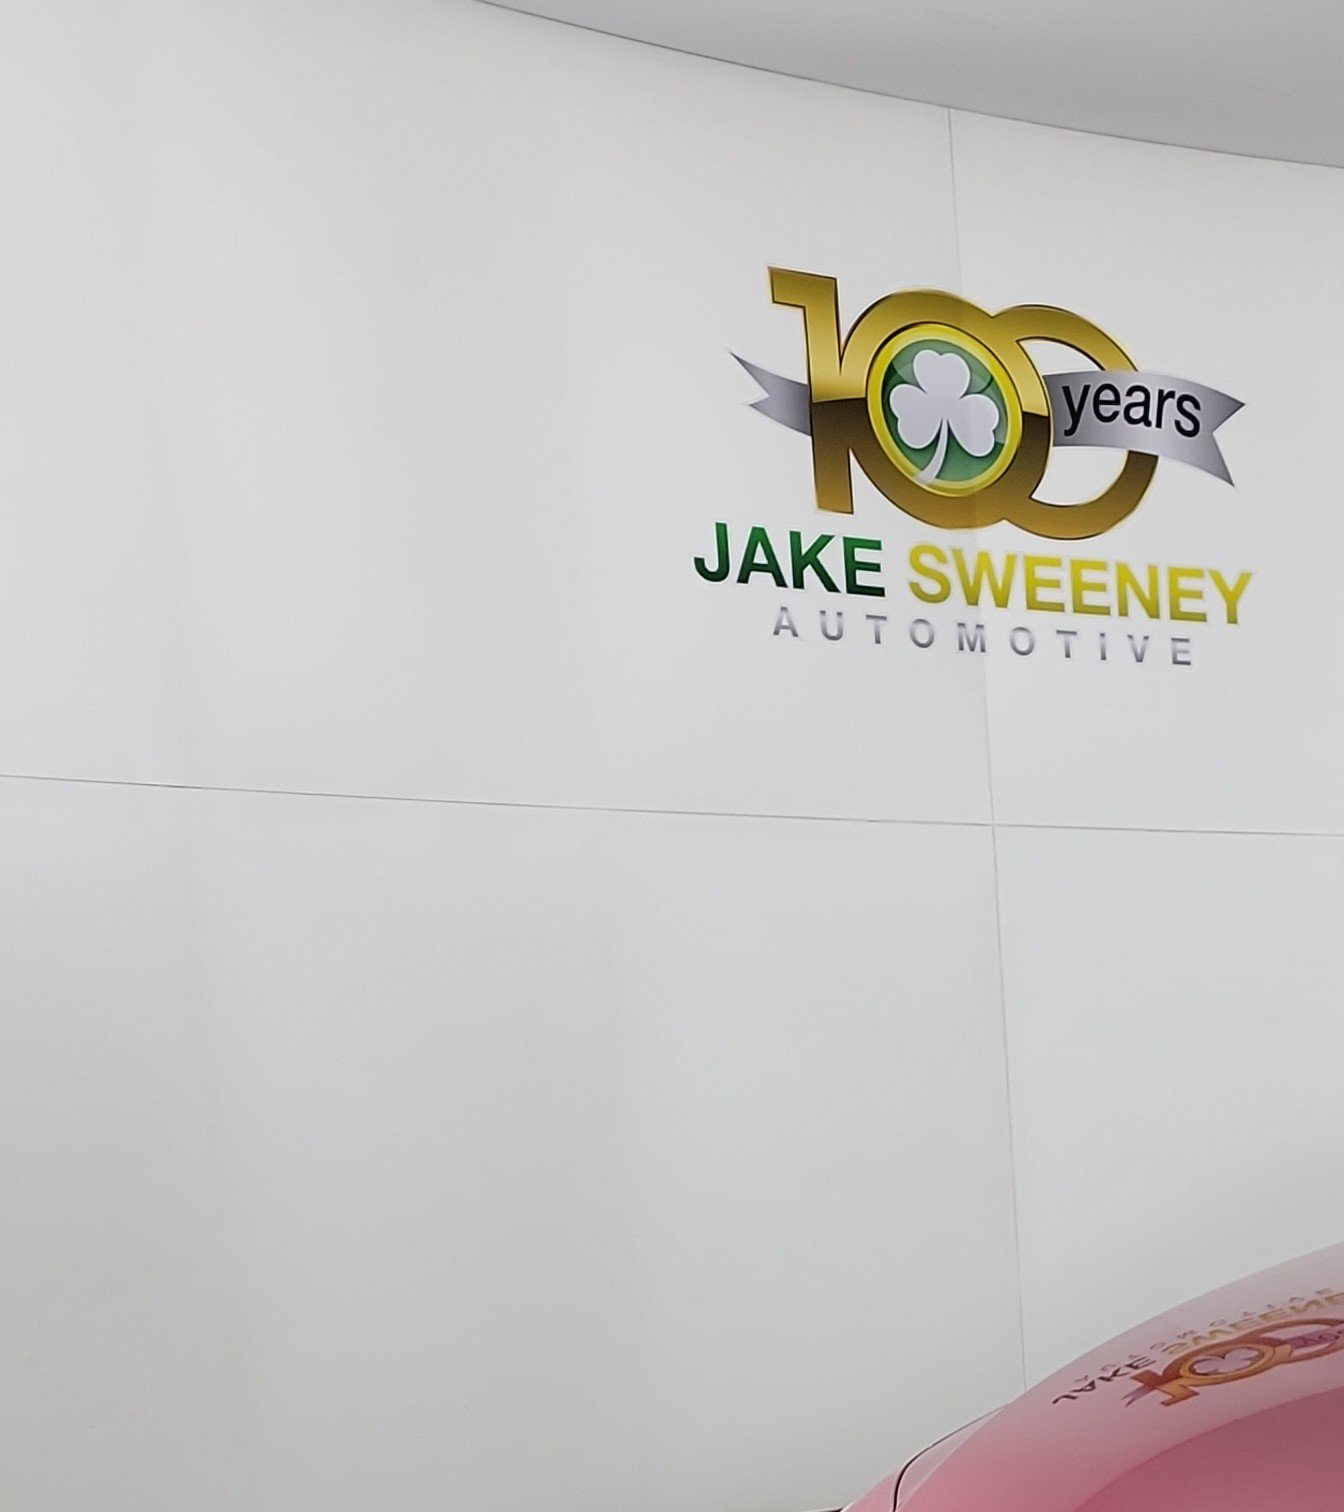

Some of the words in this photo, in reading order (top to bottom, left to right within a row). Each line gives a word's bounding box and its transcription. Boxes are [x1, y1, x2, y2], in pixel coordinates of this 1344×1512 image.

[768, 266, 1160, 541] 100
[1060, 381, 1202, 438] years
[693, 521, 886, 598] JAKE
[907, 543, 1254, 625] SWEENEY
[772, 605, 1193, 667] AUTOMOTIVE
